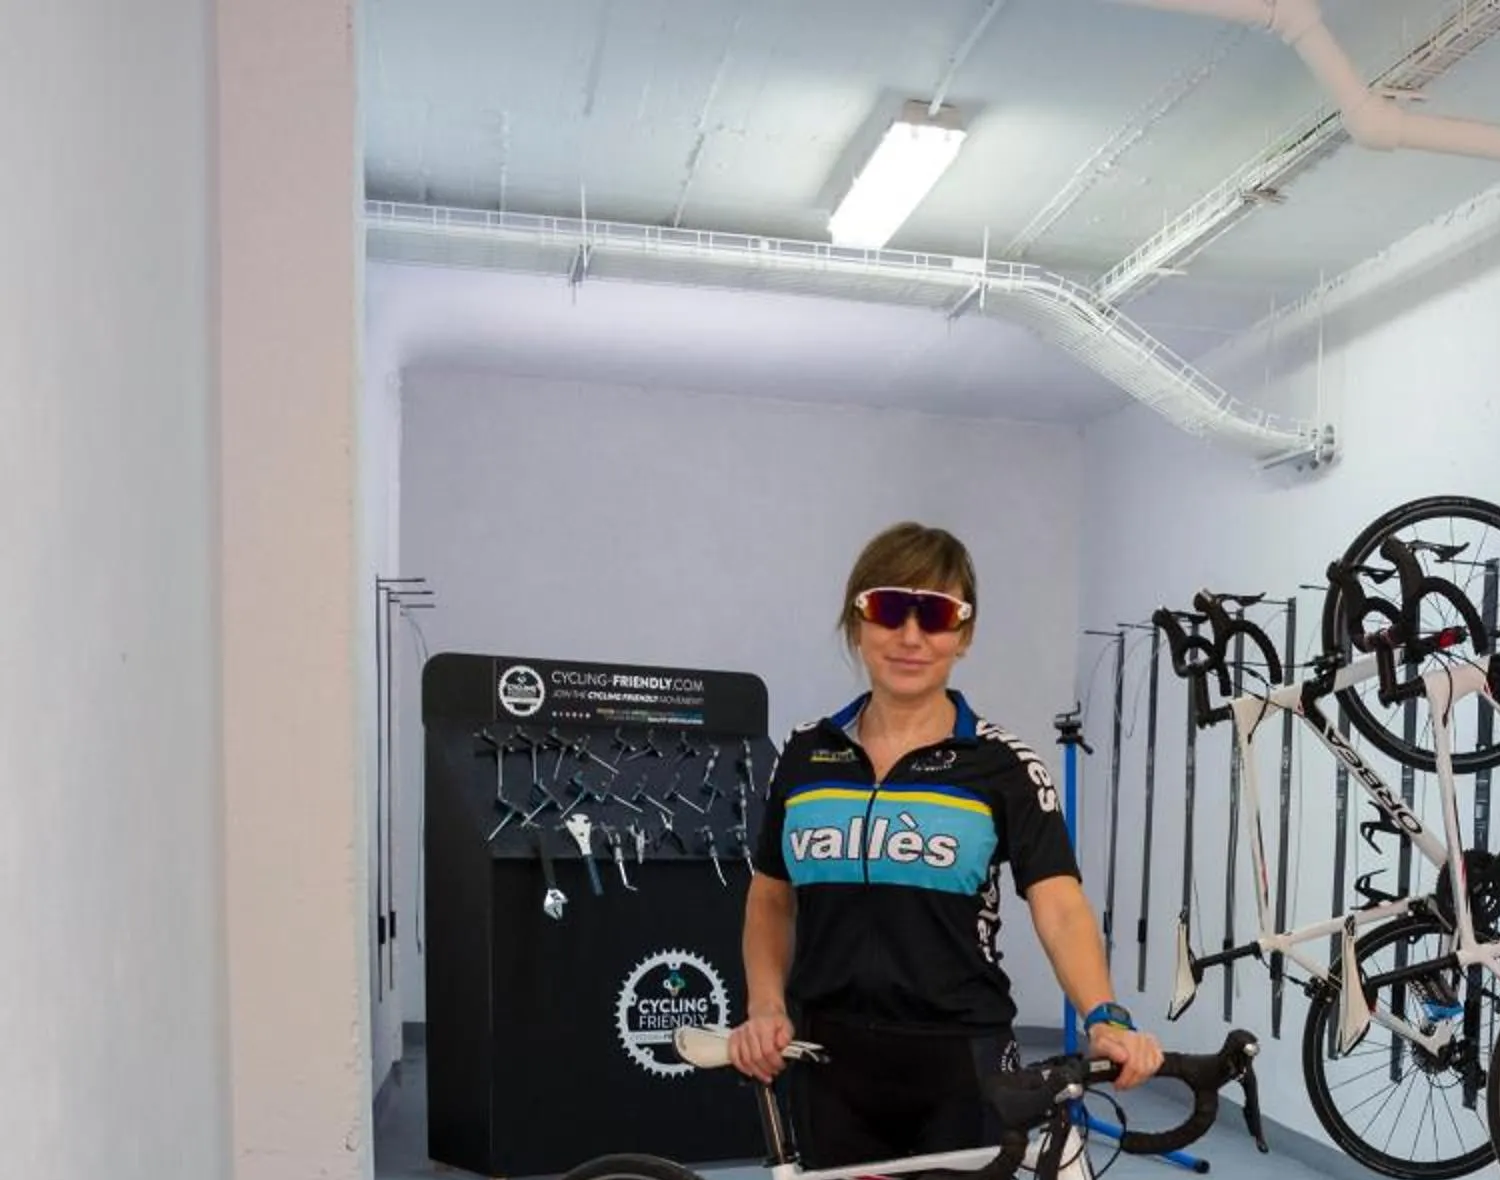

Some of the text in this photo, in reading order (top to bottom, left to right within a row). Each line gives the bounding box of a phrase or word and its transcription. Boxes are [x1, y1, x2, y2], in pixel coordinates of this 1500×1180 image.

[551, 670, 704, 692] CYCLING-FRIENDLY.COM
[1327, 727, 1422, 833] ORBEA
[789, 811, 960, 869] vallès
[638, 998, 709, 1014] CYCLING
[639, 1013, 708, 1029] FRIENDLY
